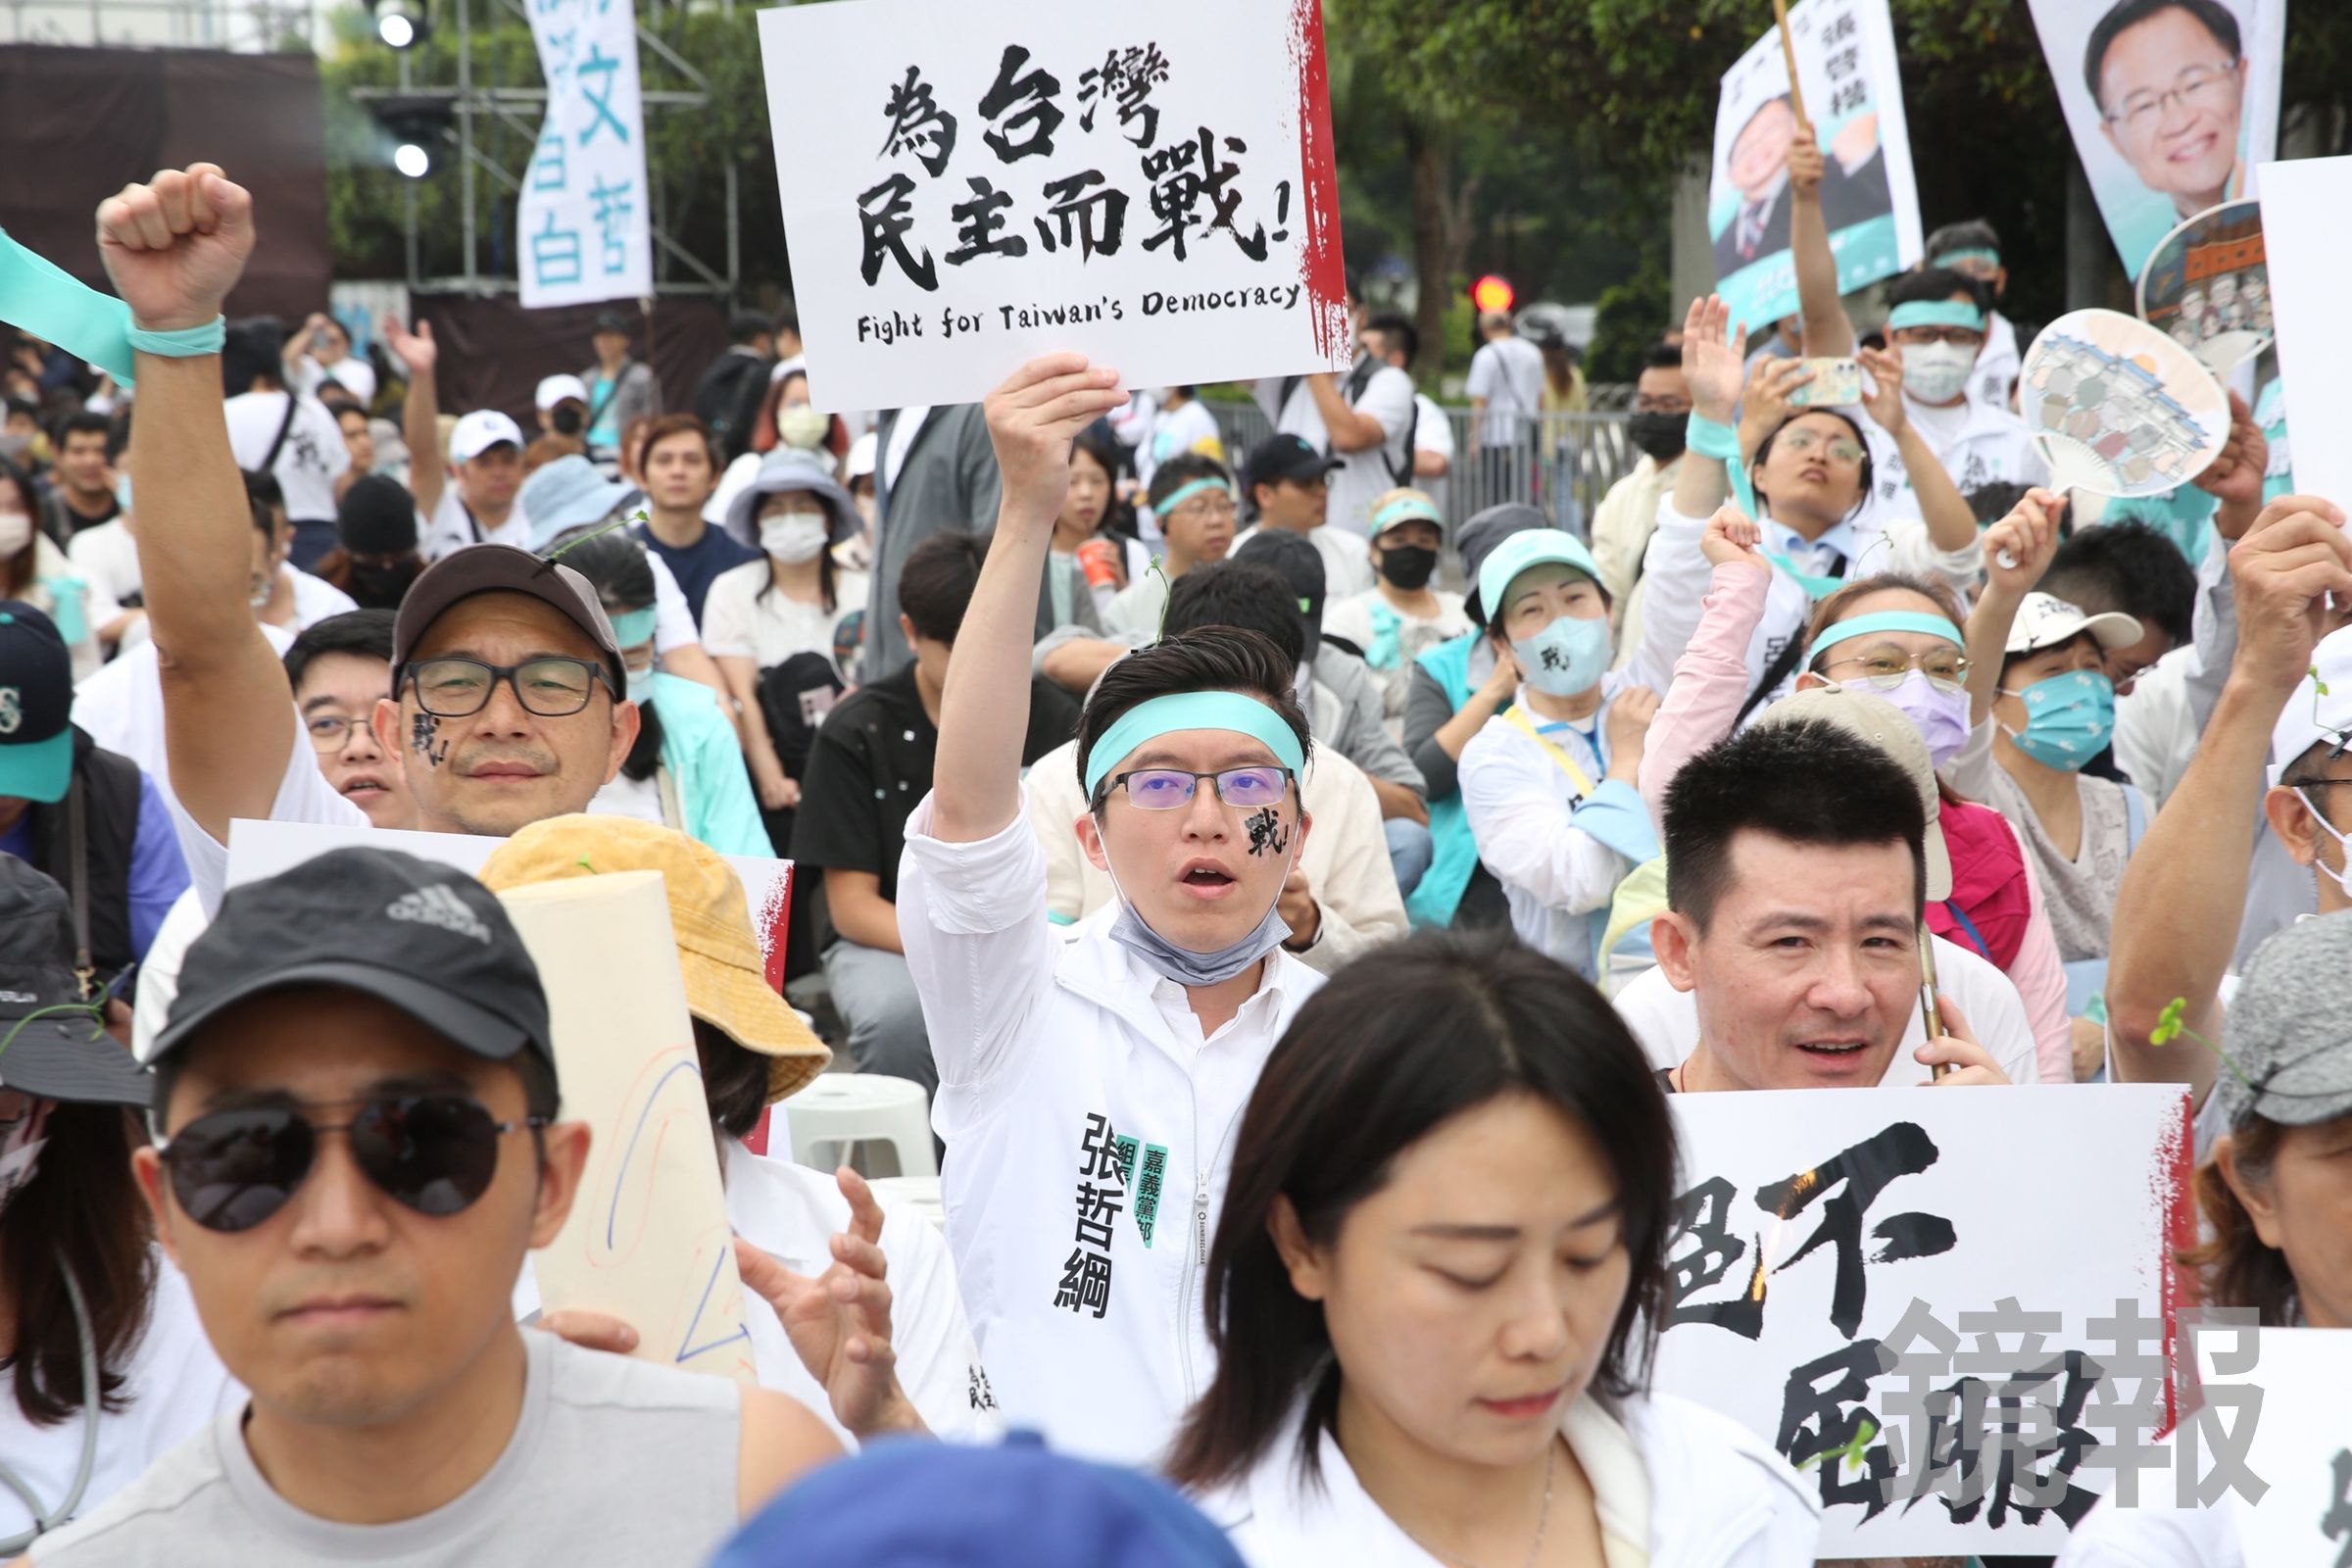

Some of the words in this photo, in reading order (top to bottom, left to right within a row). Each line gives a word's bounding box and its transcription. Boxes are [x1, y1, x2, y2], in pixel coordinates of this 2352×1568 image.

[576, 0, 632, 274] 文哲
[879, 41, 1170, 178] 為台灣
[856, 125, 1291, 292] 民主而戰!
[858, 311, 924, 345] Fight
[941, 307, 985, 338] for
[999, 296, 1124, 330] Taiwan's
[1141, 283, 1301, 316] Democracy
[386, 899, 492, 946] adidas
[1054, 1111, 1125, 1319] 張哲綱
[1134, 1150, 1166, 1244] 嘉義黨部
